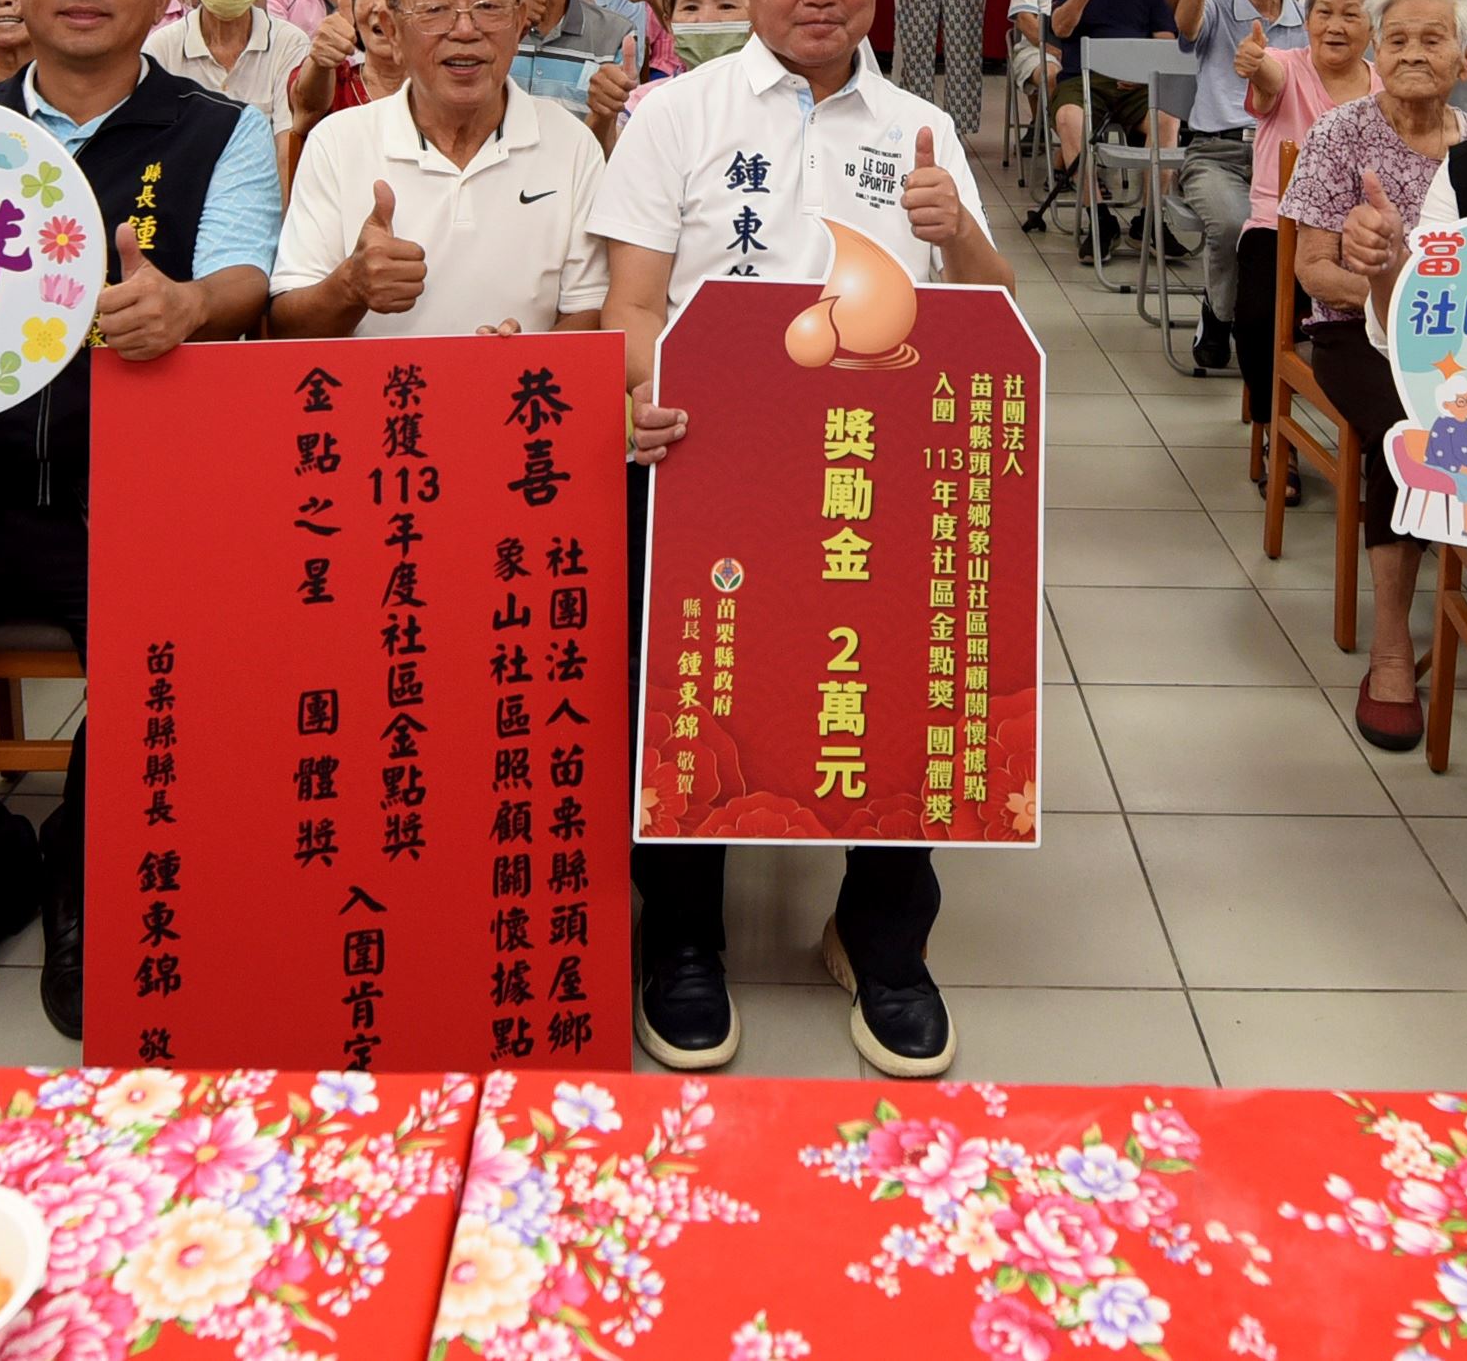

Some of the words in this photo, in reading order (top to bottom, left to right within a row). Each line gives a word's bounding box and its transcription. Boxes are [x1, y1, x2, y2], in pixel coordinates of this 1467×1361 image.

[135, 161, 163, 209] 縣長
[724, 150, 773, 276] 鍾東
[858, 174, 897, 194] SPORTIF
[863, 157, 874, 172] LE
[875, 161, 896, 177] COQ
[504, 368, 573, 508] 恭喜
[923, 448, 964, 470] 113
[932, 372, 956, 423] 入圍
[1001, 373, 1026, 477] 社團法人
[293, 367, 342, 605] 金點之星
[821, 407, 875, 582] 獎勵金
[368, 364, 440, 864] 榮獲113年度社區金點獎
[682, 598, 702, 641] 縣長
[927, 479, 959, 710] 年度社區金點獎
[963, 373, 993, 803] 苗栗縣頭屋鄉象山社區照顧關懷據點
[674, 650, 703, 741] 鍾東錦
[712, 598, 736, 718] 苗栗縣政府
[814, 626, 868, 800] 2萬元
[143, 641, 177, 827] 苗栗縣縣長
[293, 688, 339, 869] 團體獎
[545, 537, 593, 1056] 社團法人苗栗縣頭屋鄉
[676, 750, 696, 796] 敬賀
[925, 726, 954, 826] 團體獎
[489, 537, 533, 1062] 象山社區照顧關懷據點
[134, 849, 182, 998] 鍾東錦
[139, 1027, 176, 1069] 敬
